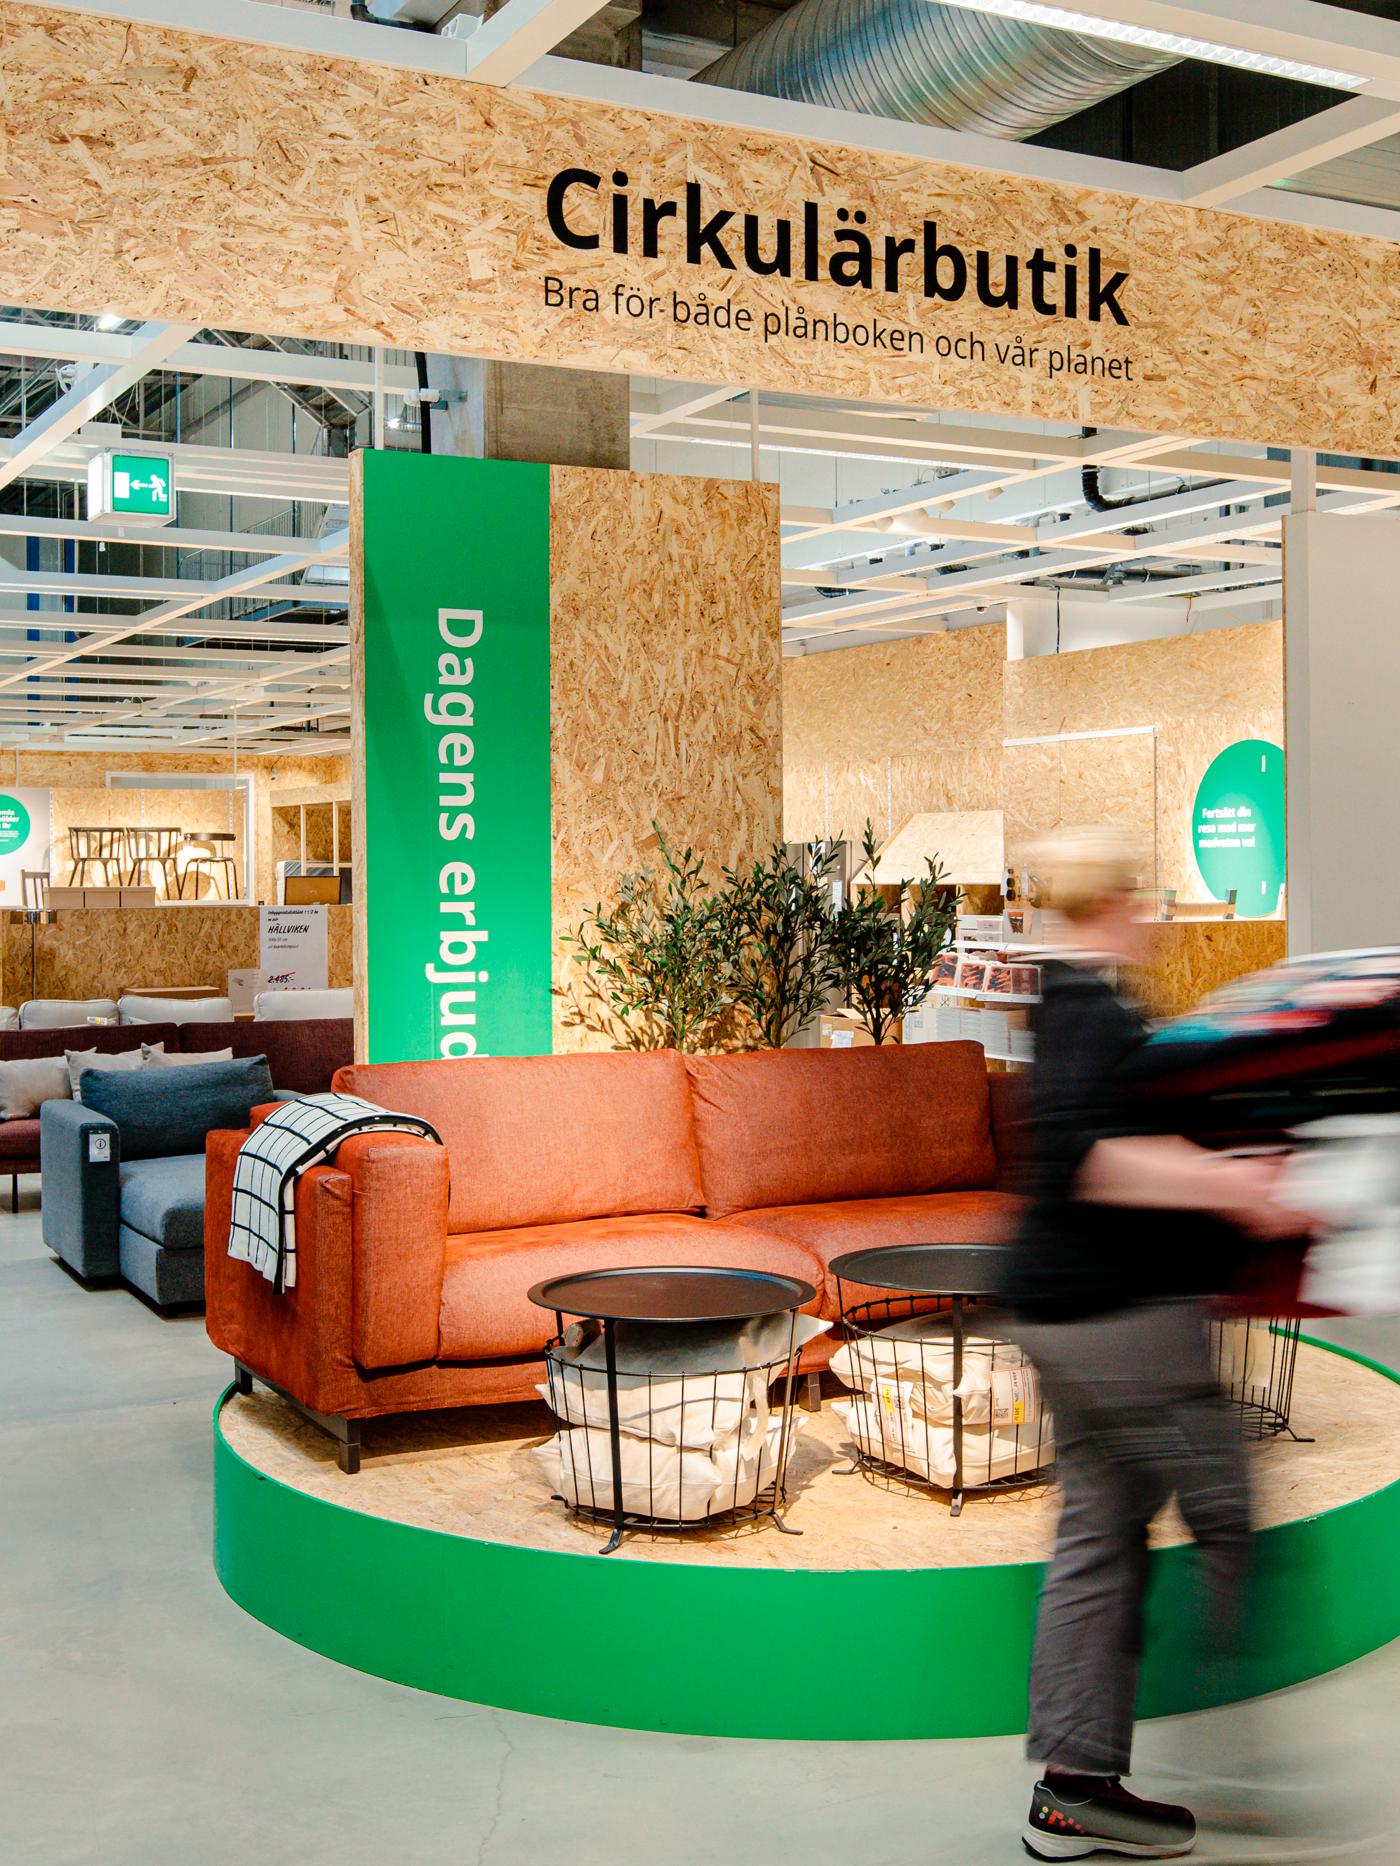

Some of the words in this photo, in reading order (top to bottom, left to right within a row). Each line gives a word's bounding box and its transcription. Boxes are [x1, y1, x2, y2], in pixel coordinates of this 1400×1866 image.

[546, 167, 1130, 327] Cirkulärbutik
[544, 276, 599, 313] Bra
[612, 283, 661, 319] för
[673, 291, 752, 331] både
[764, 306, 924, 354] plånboken
[935, 332, 985, 362] och
[995, 336, 1039, 368] vår
[1048, 345, 1134, 381] planet
[424, 608, 483, 841] Dagens
[267, 923, 310, 934] HÄLLVIKEN
[426, 861, 490, 1060] erbjud
